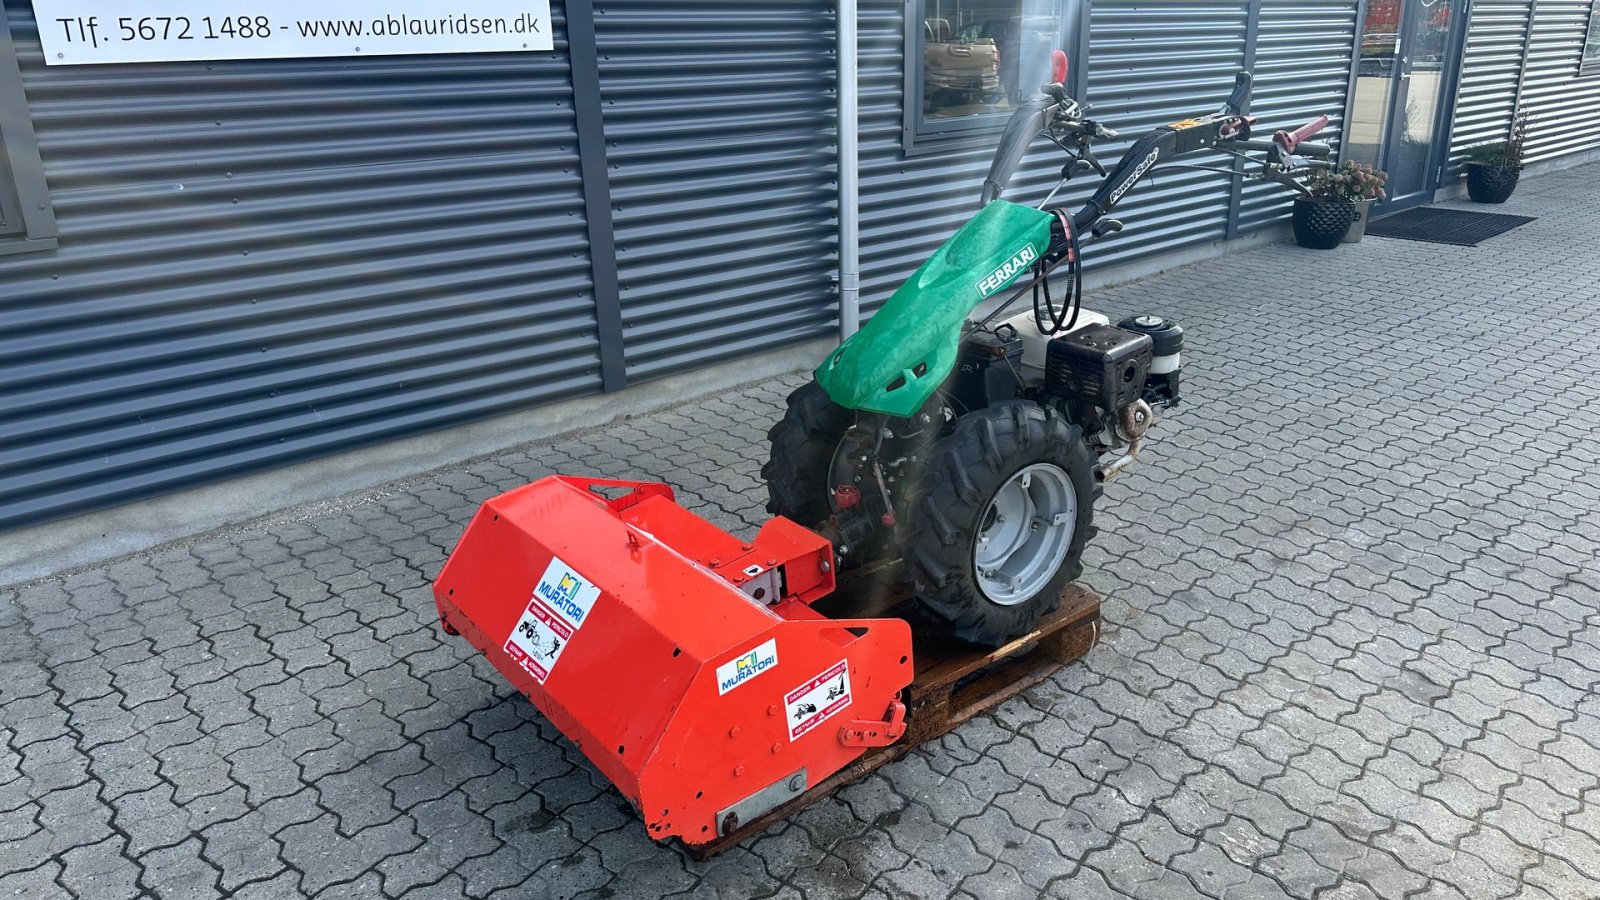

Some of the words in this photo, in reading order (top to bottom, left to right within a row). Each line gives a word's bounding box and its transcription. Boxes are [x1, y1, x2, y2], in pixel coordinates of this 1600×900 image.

[56, 16, 109, 48] Tlf.
[118, 16, 194, 41] 5672
[202, 15, 271, 39] 1488
[296, 13, 541, 37] www.ablauridsen.dk
[978, 246, 1036, 296] FERRARI
[538, 581, 585, 623] MURATORI
[721, 655, 775, 691] MURATORI
[789, 685, 811, 702] DANGER
